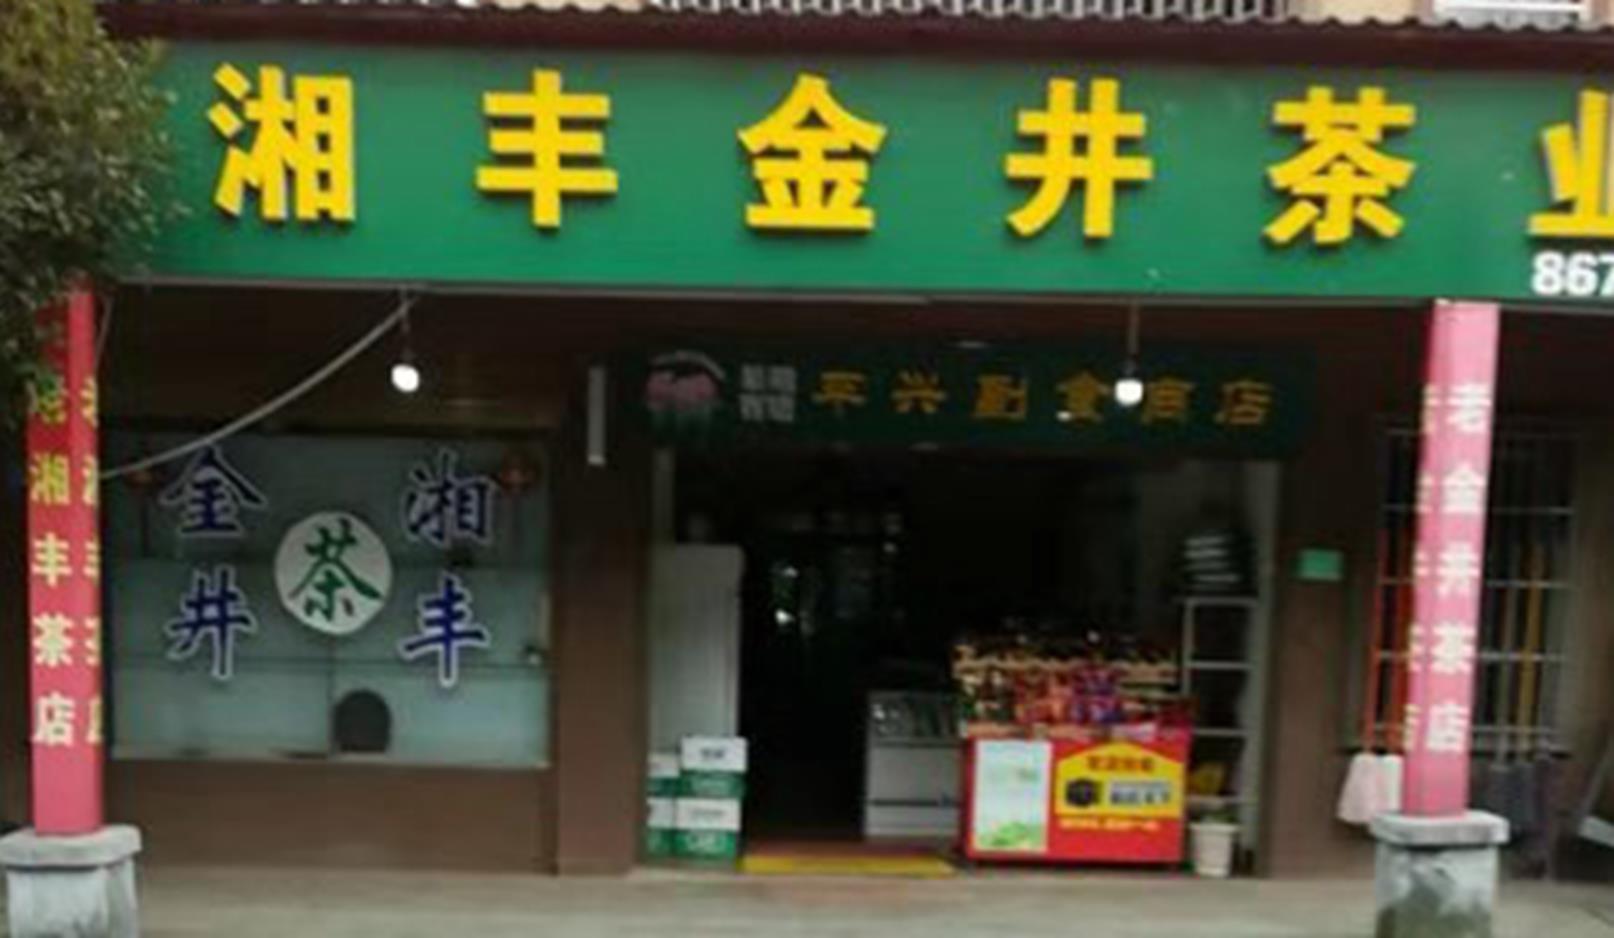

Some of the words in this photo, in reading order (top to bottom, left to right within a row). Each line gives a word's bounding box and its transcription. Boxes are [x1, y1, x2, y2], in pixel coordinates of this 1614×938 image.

[207, 62, 1614, 246] 湘丰金井茶业
[160, 444, 269, 682] 金井
[286, 517, 384, 622] 茶
[399, 446, 498, 688] 湘丰
[1425, 382, 1493, 753] 老金井茶店
